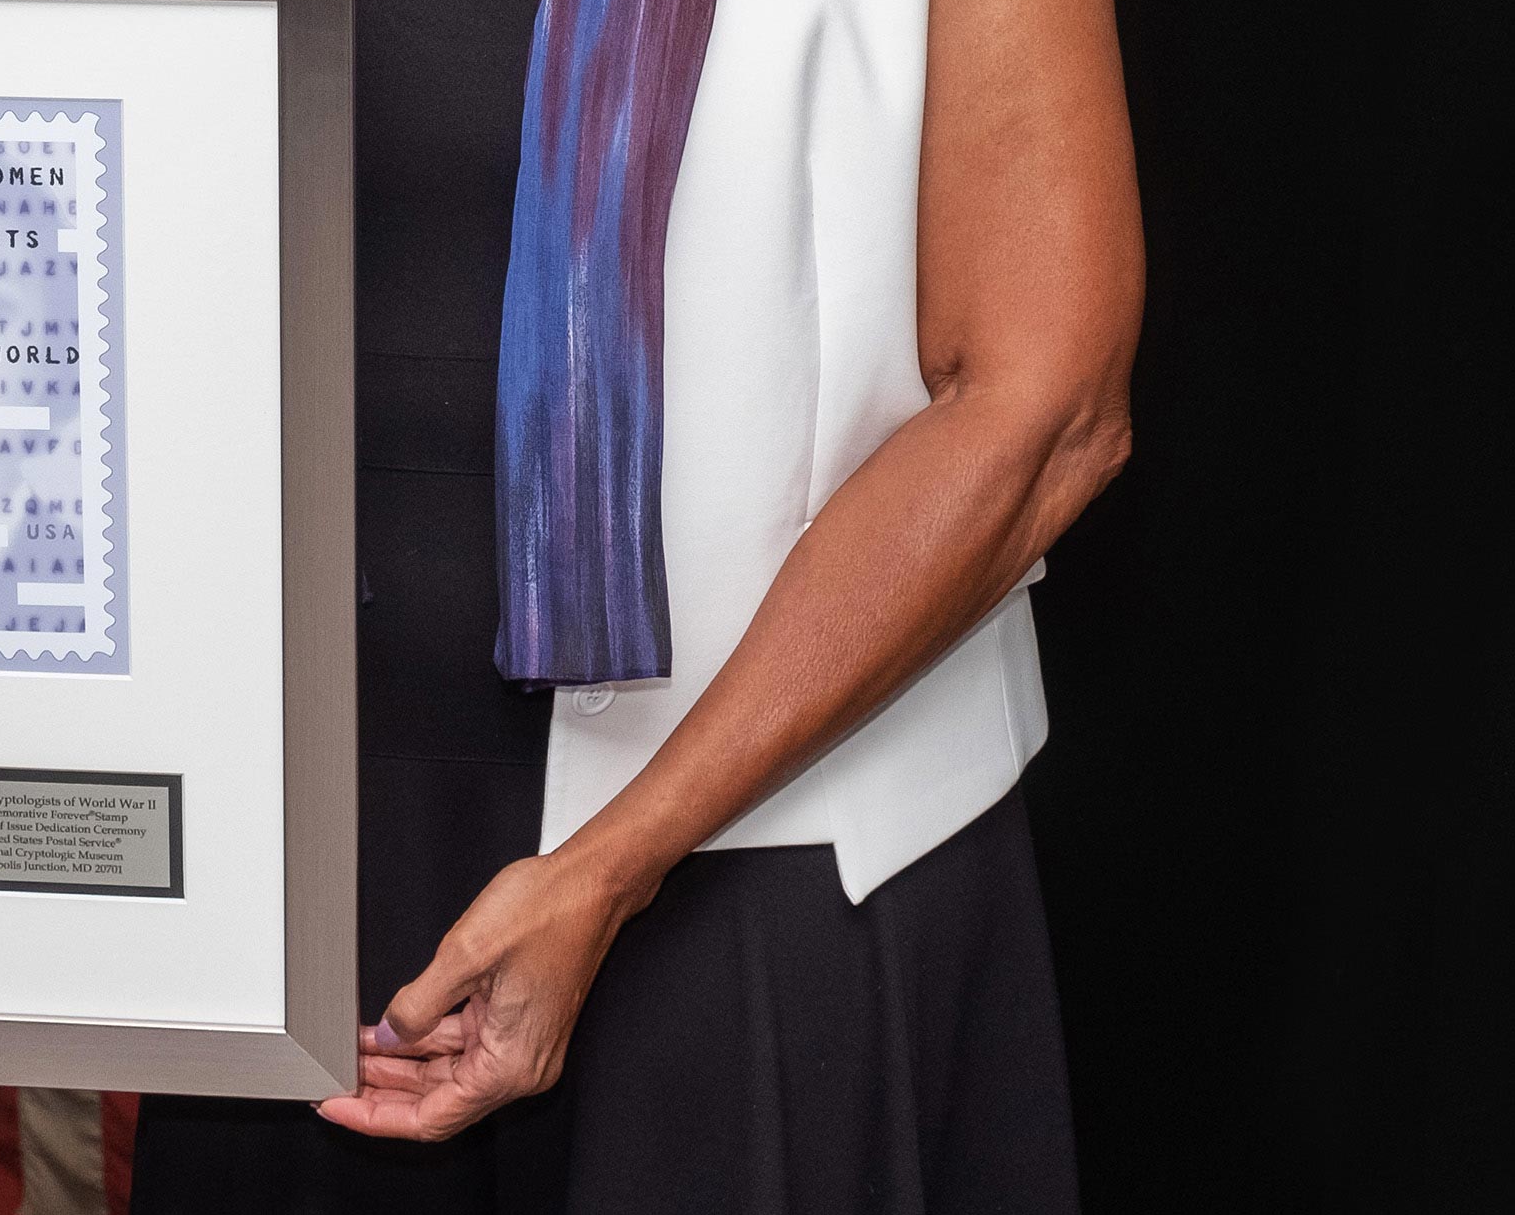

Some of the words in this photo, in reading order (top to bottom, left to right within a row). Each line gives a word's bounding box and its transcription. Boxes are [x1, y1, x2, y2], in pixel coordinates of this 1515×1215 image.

[26, 524, 75, 540] USA
[63, 796, 76, 807] of
[78, 797, 116, 809] World
[119, 799, 145, 810] War
[148, 800, 157, 810] II
[7, 821, 33, 832] Issue
[35, 822, 91, 835] Dedication
[94, 824, 147, 839] Ceremony
[12, 834, 43, 845] States
[46, 836, 77, 846] Postal
[15, 847, 77, 862] Cryptologic
[78, 850, 124, 861] Museum
[24, 861, 70, 873] Junction,
[72, 863, 92, 873] MD
[95, 864, 123, 875] 20701
